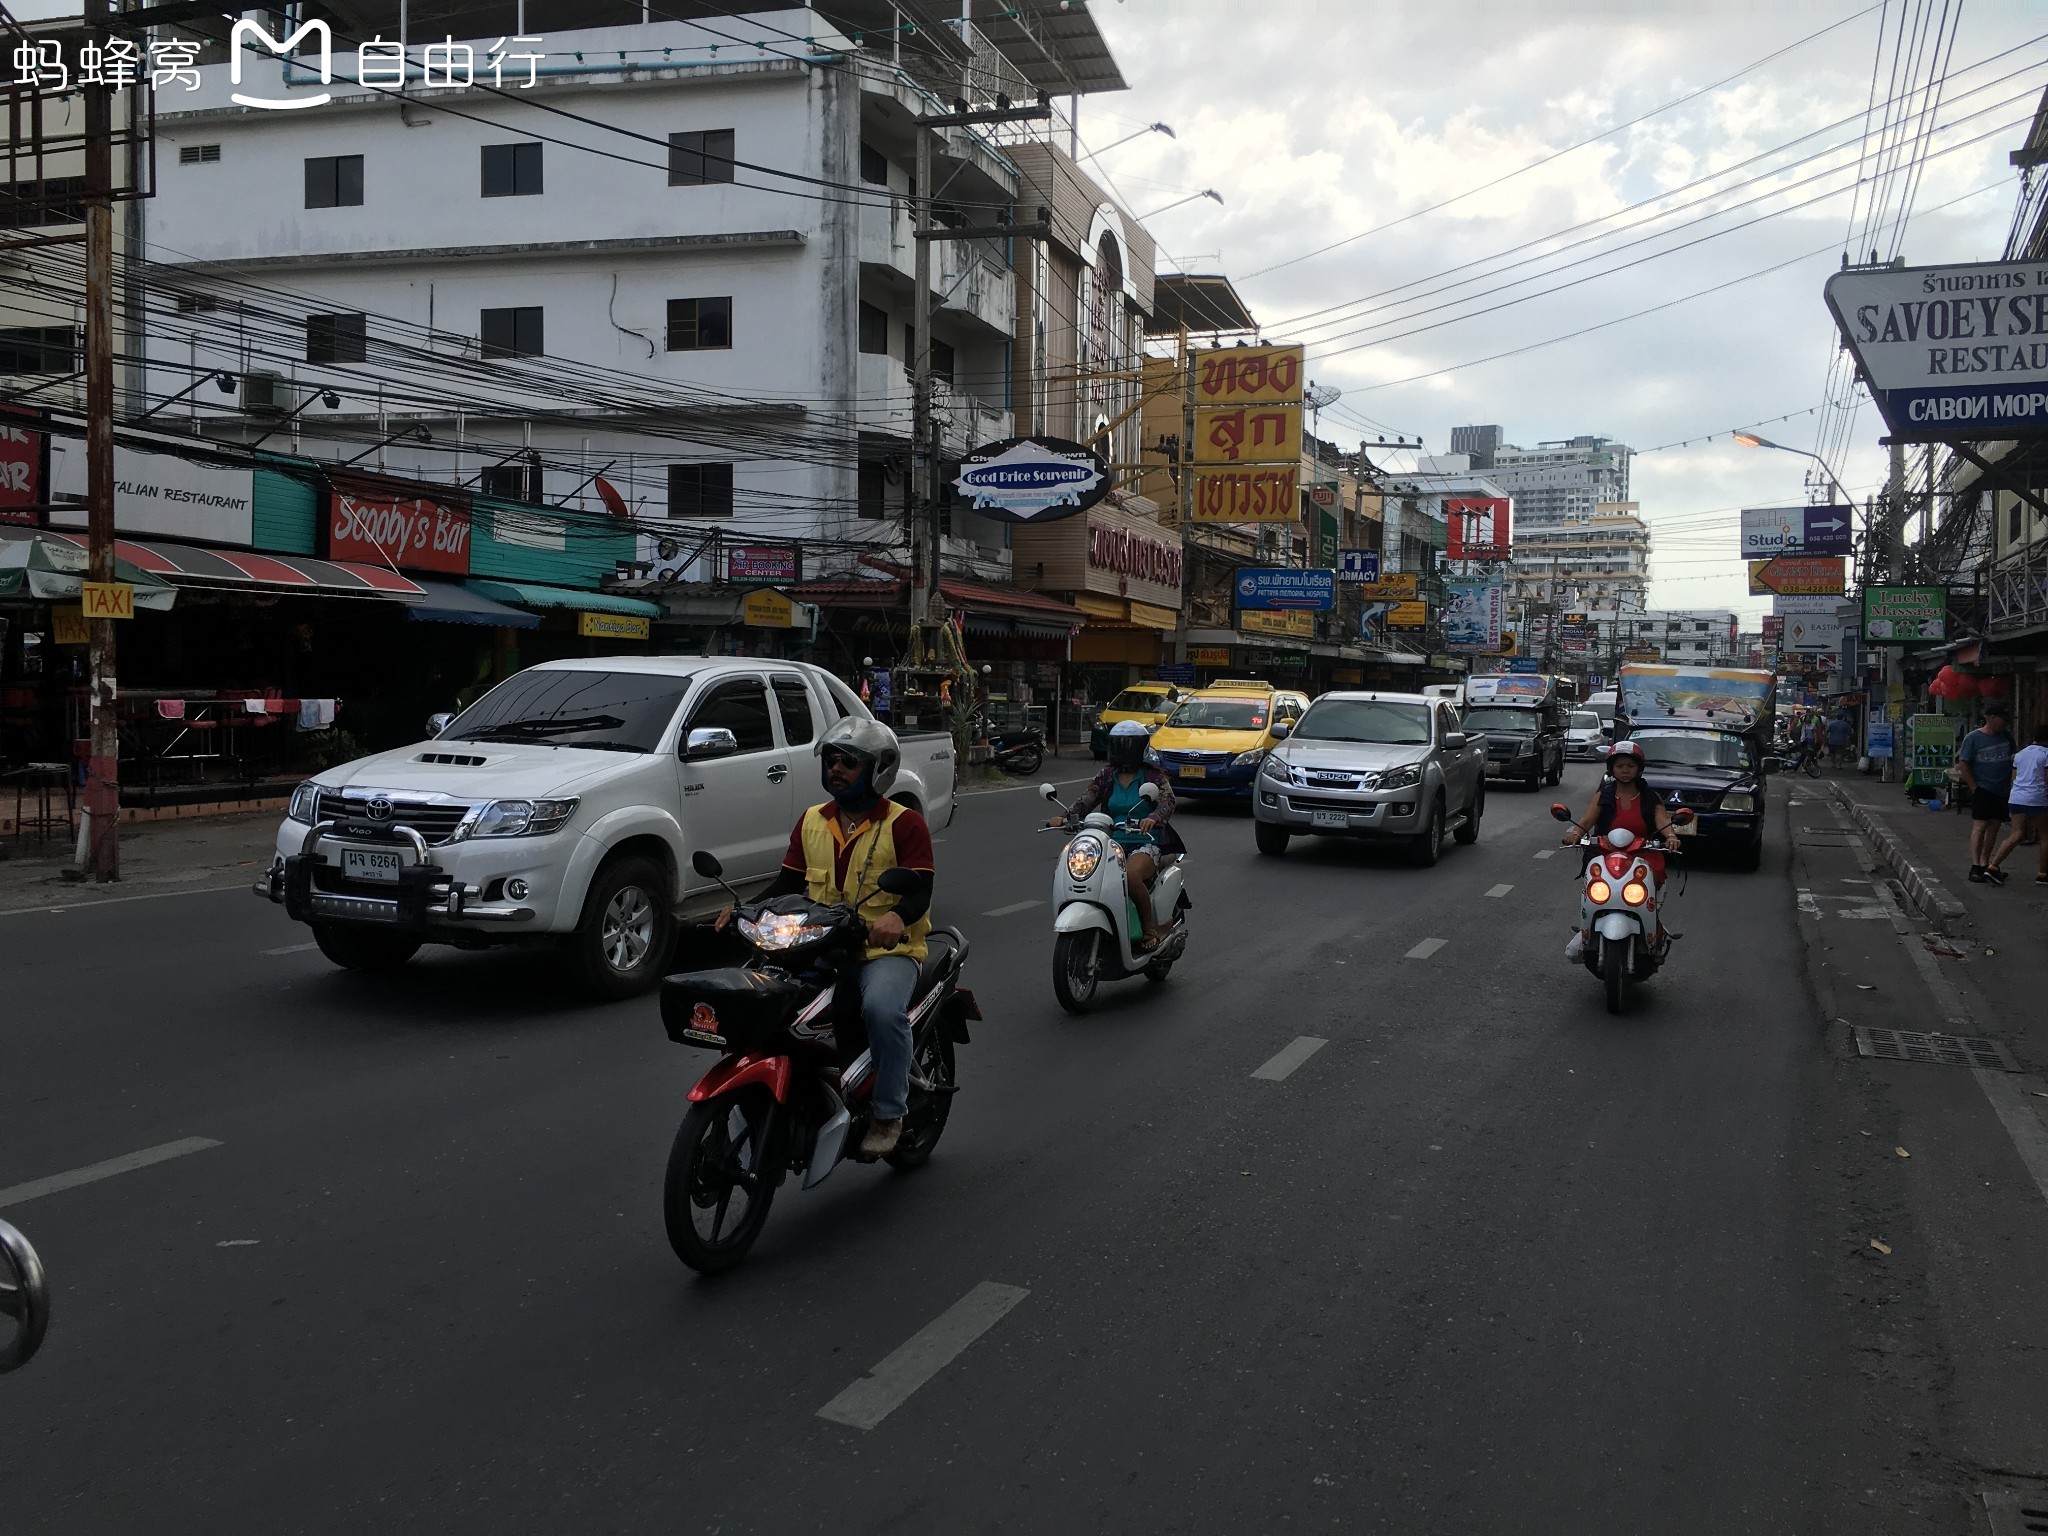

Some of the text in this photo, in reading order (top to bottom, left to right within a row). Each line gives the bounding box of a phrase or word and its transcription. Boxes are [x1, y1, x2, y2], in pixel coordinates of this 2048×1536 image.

[1856, 296, 2006, 344] SAVOEY
[1210, 409, 1287, 461] สุก
[967, 468, 1088, 484] Good Price Souvenir
[113, 480, 249, 511] TALIAN RESTAURANT
[1198, 468, 1295, 516] เยาวราช
[335, 496, 471, 561] Scooby's Bar
[752, 560, 795, 571] BOOKING
[84, 587, 132, 614] TAXI
[1306, 591, 1330, 599] HOSPITAL
[1879, 590, 1934, 611] Lucky
[1871, 604, 1942, 618] Massage
[57, 615, 88, 640] TAX
[594, 618, 641, 636] Nantiya Bar
[1811, 623, 1841, 632] EASTIN
[1318, 772, 1351, 782] ISUZU
[1329, 813, 1346, 822] 2222
[370, 854, 397, 869] 6264
